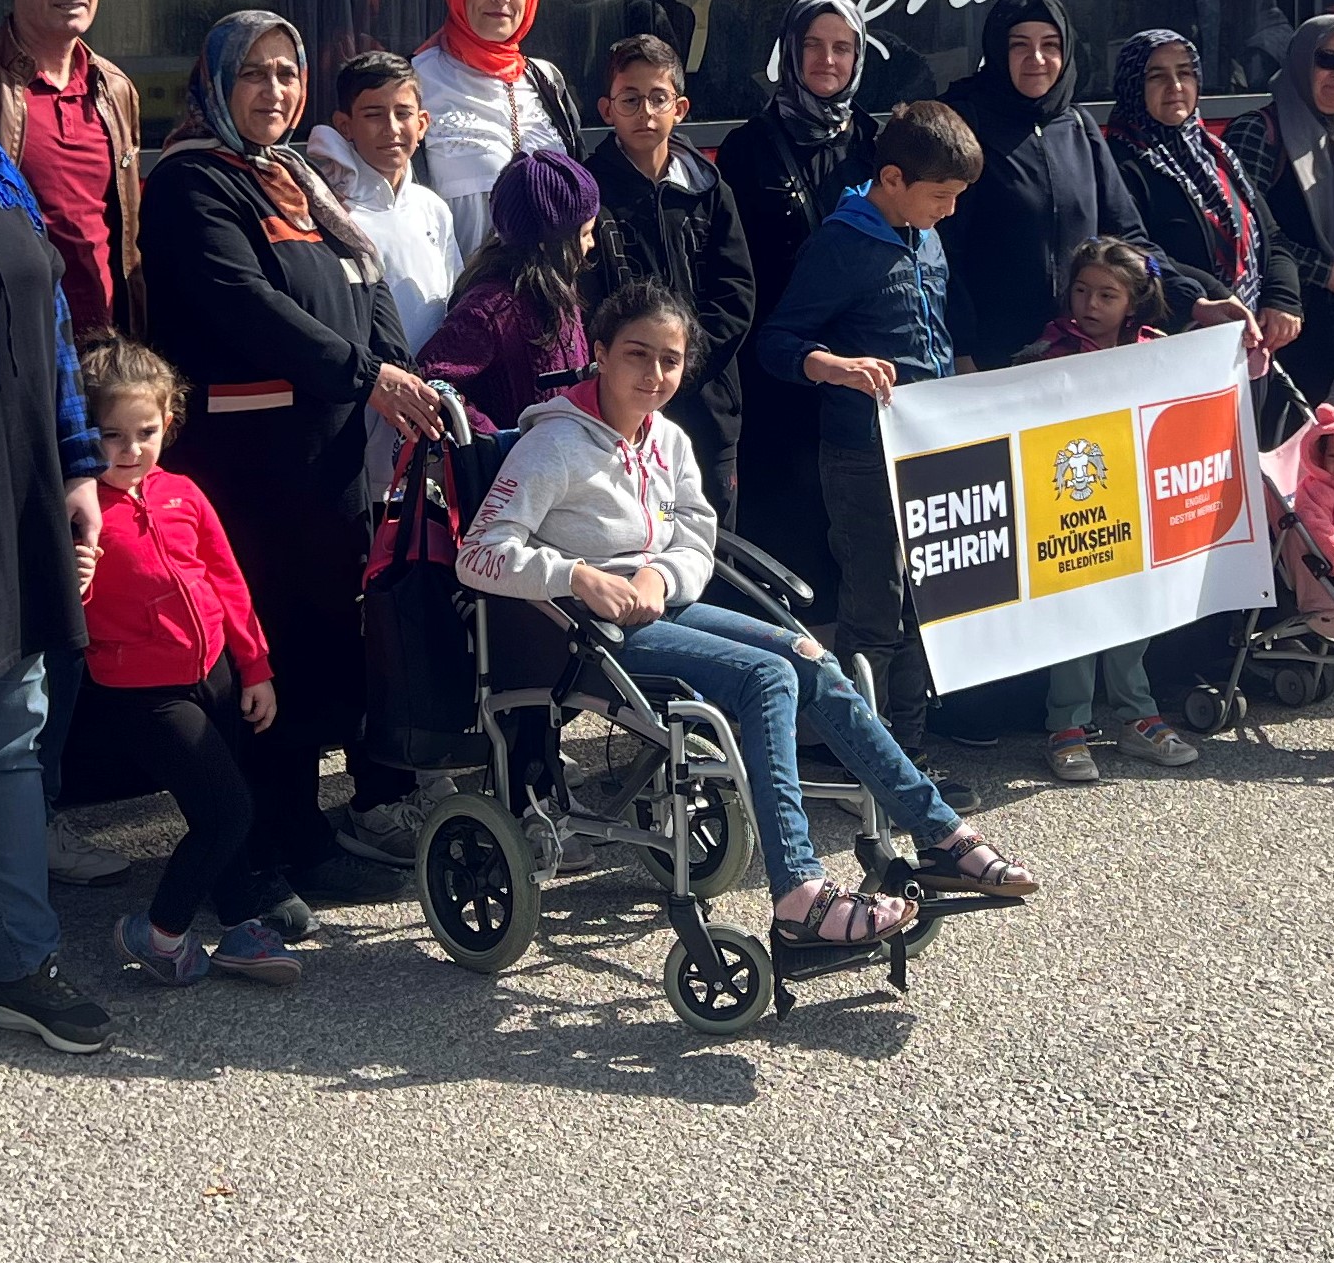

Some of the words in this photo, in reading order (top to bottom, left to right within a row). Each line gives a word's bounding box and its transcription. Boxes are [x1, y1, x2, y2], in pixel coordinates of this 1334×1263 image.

[1154, 449, 1233, 500] ENDEM
[1060, 506, 1107, 530] KONYA
[1037, 519, 1132, 562] BÜYÜKŞEHİR
[1058, 546, 1114, 573] BELEDİYESİ
